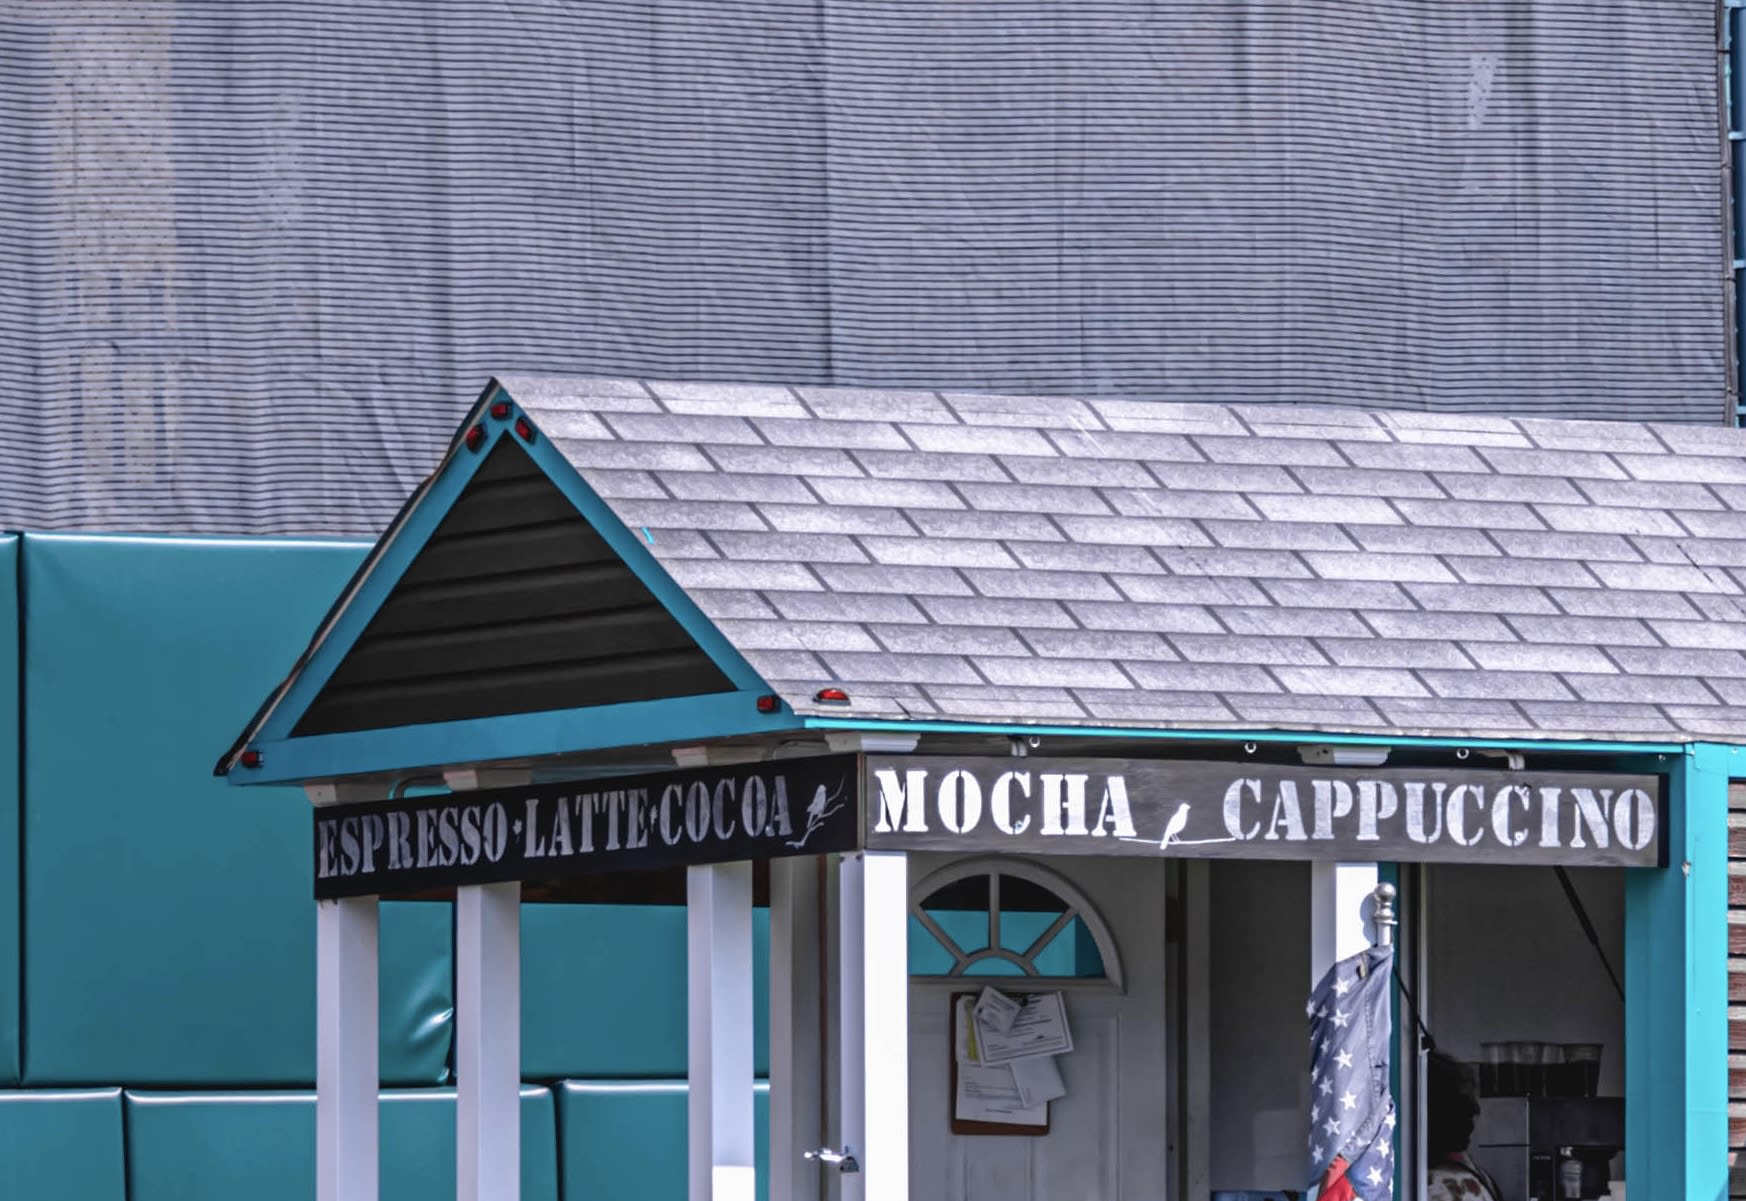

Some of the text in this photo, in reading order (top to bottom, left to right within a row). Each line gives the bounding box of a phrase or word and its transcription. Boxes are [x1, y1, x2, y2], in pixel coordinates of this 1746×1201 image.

[317, 774, 793, 879] ESPRESSO LATTE COCOA
[873, 768, 1657, 851] MOCHA CAPPUCCINO
